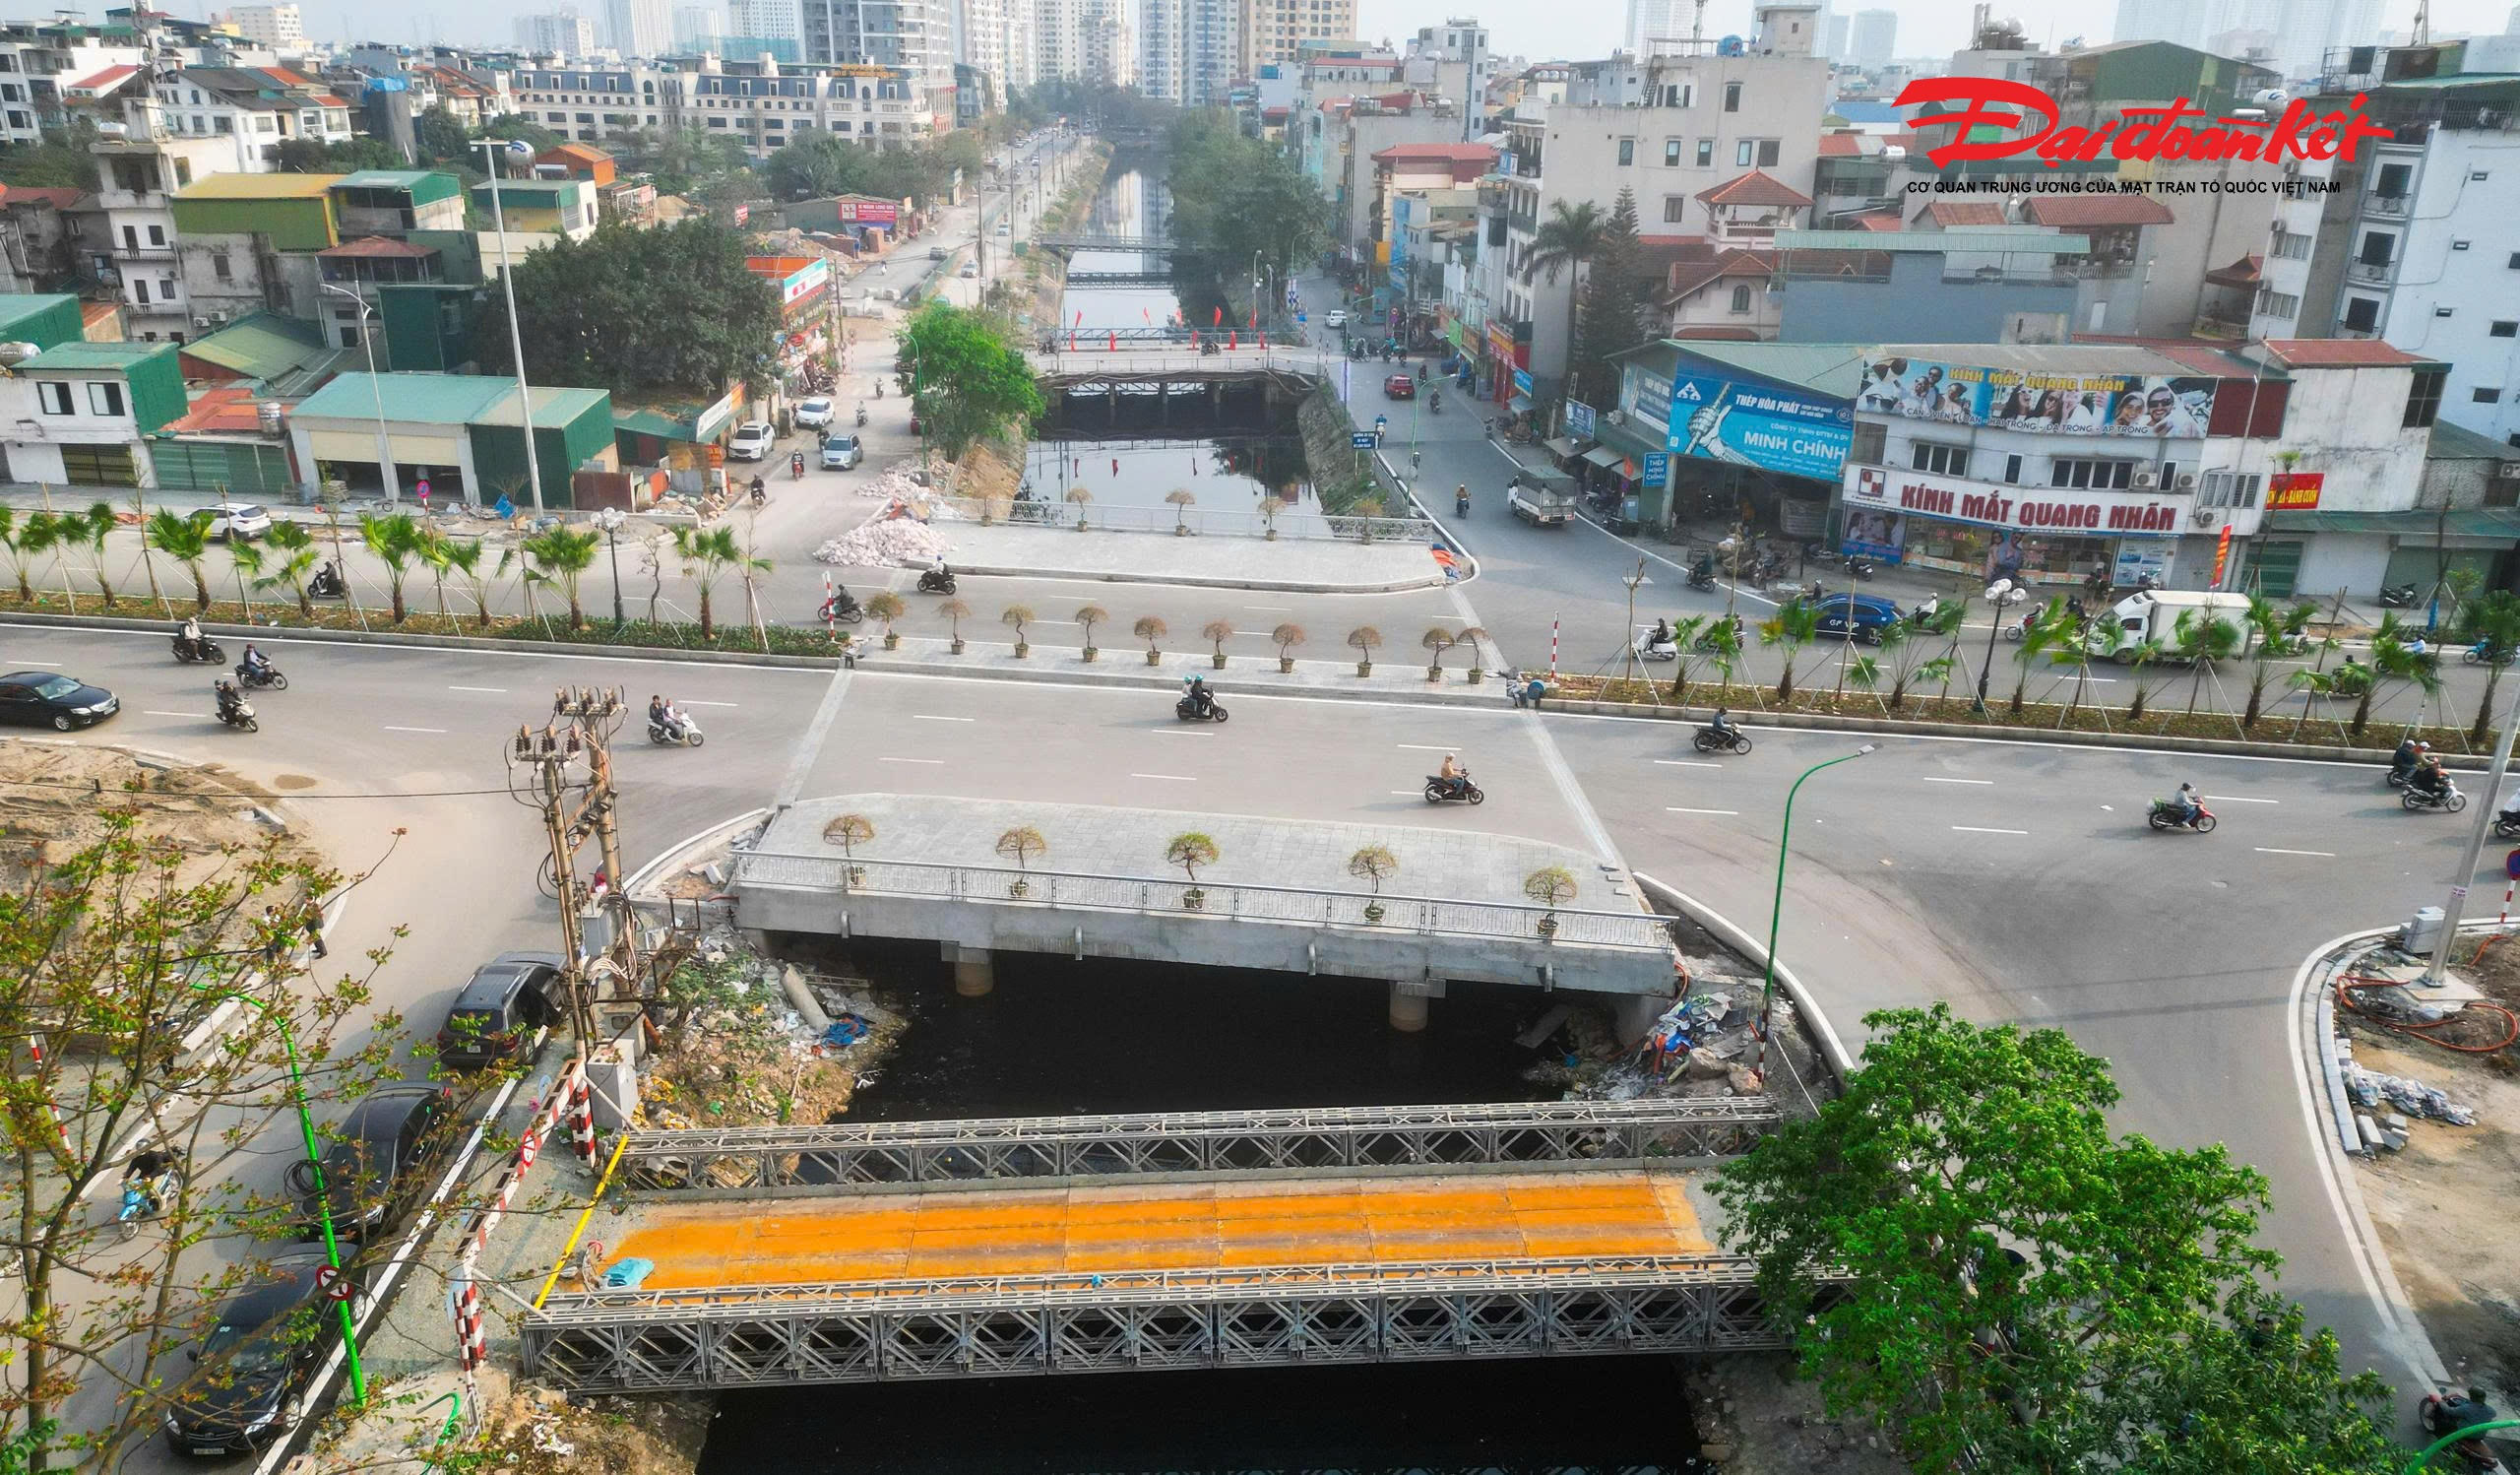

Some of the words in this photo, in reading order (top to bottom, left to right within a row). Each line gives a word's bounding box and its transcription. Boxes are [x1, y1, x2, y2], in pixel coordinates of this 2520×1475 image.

[2025, 375, 2079, 391] QUANG
[1736, 394, 1757, 407] THÉP
[1776, 400, 1800, 415] PHÁT
[1744, 430, 1788, 451] MINH
[1793, 438, 1847, 461] CHÍNH
[1900, 482, 1955, 515] KÍNH
[1961, 489, 2013, 523] MẮT
[2018, 501, 2102, 529] QUANG
[2108, 501, 2177, 531] NHÃN
